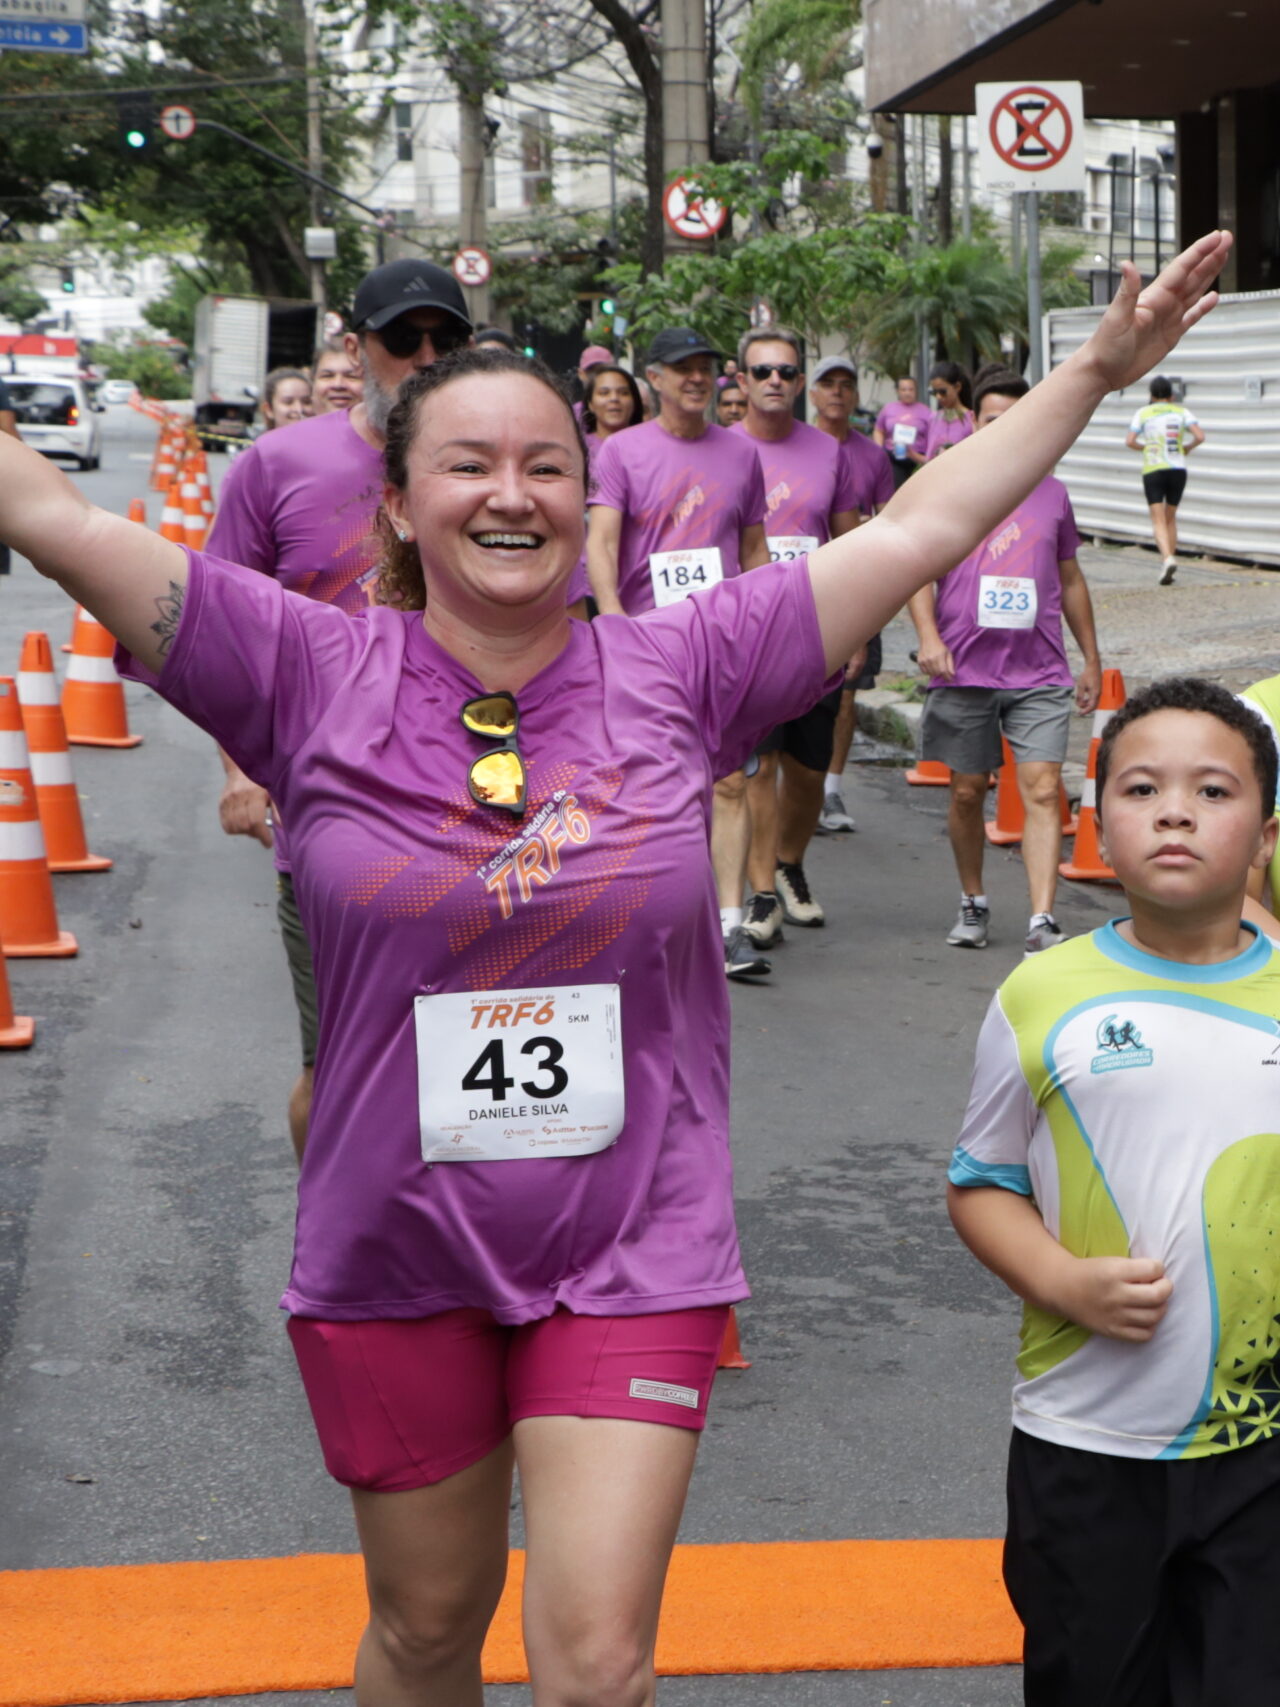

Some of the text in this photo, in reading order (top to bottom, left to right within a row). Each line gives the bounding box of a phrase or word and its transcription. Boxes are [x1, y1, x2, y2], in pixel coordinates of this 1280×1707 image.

[659, 564, 707, 587] 184
[984, 590, 1029, 611] 323
[484, 795, 591, 920] TRF6
[488, 837, 525, 870] corrida
[470, 1000, 556, 1030] TRF6
[568, 1014, 590, 1023] 5KM
[461, 1036, 569, 1101] 43
[469, 1103, 569, 1121] DANIELE SILVA
